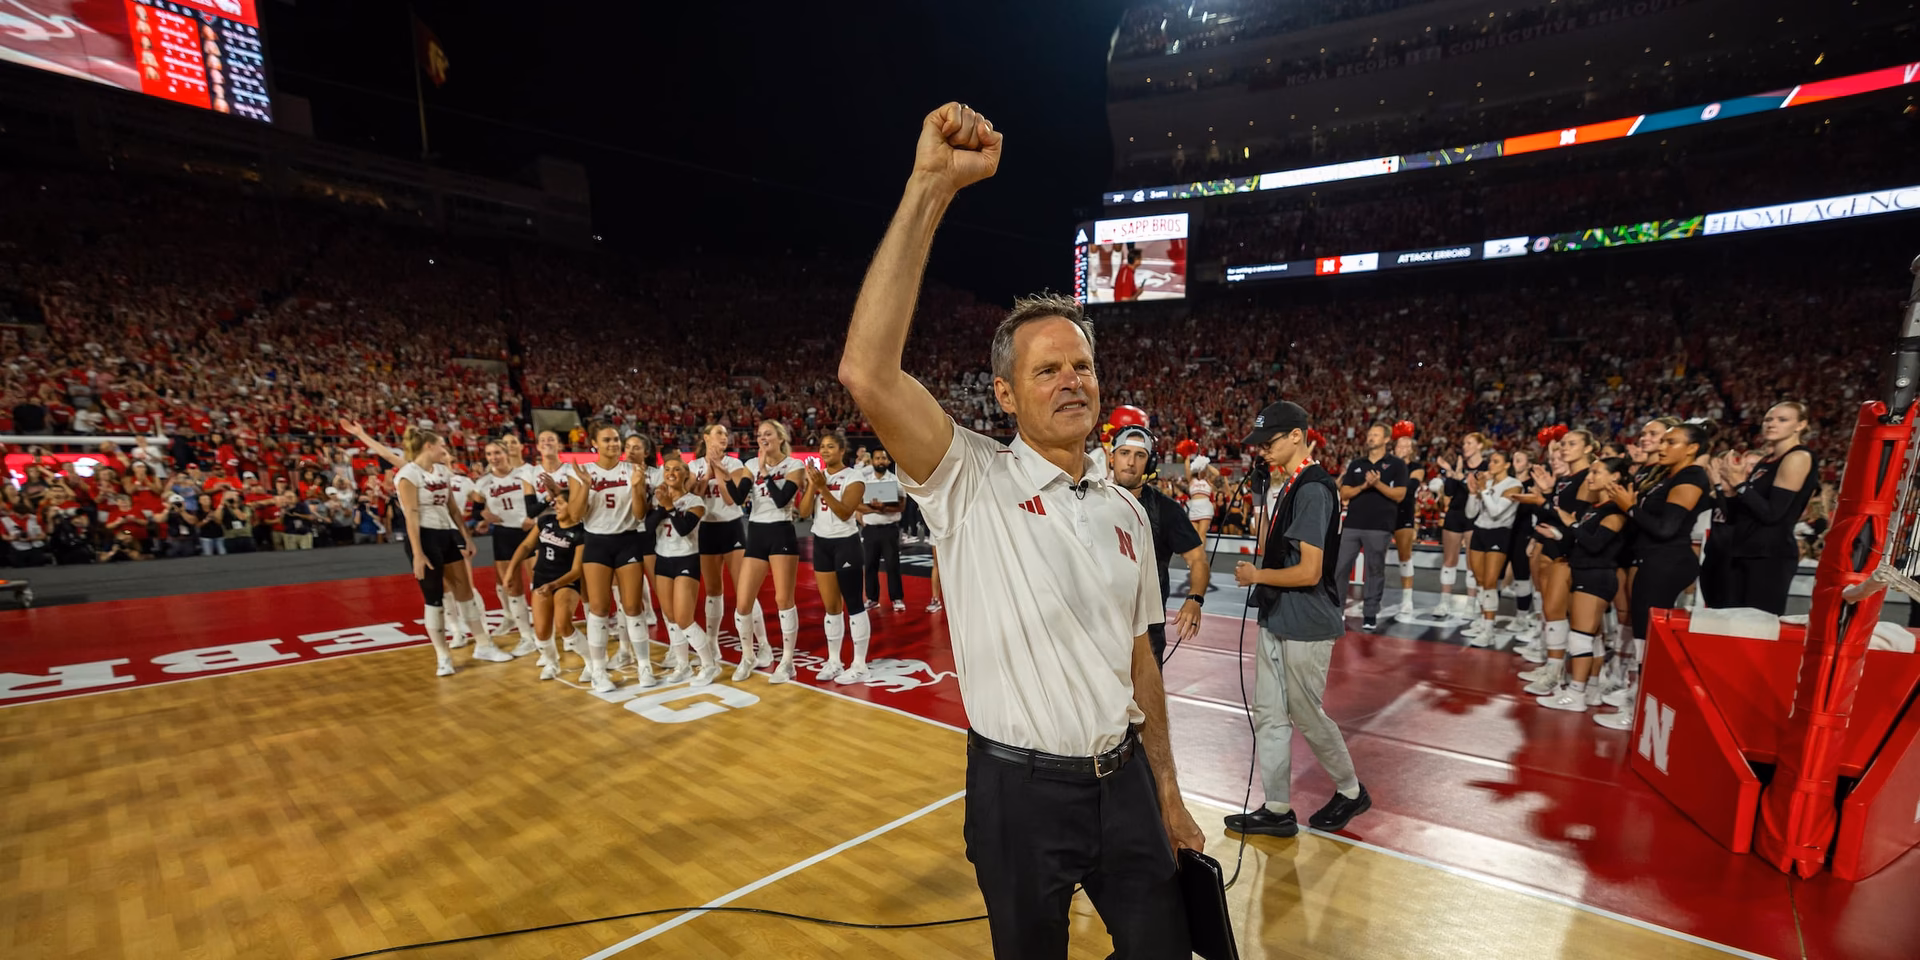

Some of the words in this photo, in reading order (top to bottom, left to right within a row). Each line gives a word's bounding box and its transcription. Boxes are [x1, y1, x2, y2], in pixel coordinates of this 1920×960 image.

[1121, 219, 1149, 237] SAPP
[1152, 219, 1182, 233] BROS
[1721, 207, 1802, 232] HOME
[1397, 251, 1433, 264] ATTACK
[1433, 247, 1471, 260] ERRORS
[1322, 259, 1336, 273] N
[502, 497, 514, 510] 11
[605, 493, 615, 509] 5
[664, 524, 672, 537] 7
[1114, 525, 1138, 563] N
[1638, 692, 1676, 776] N
